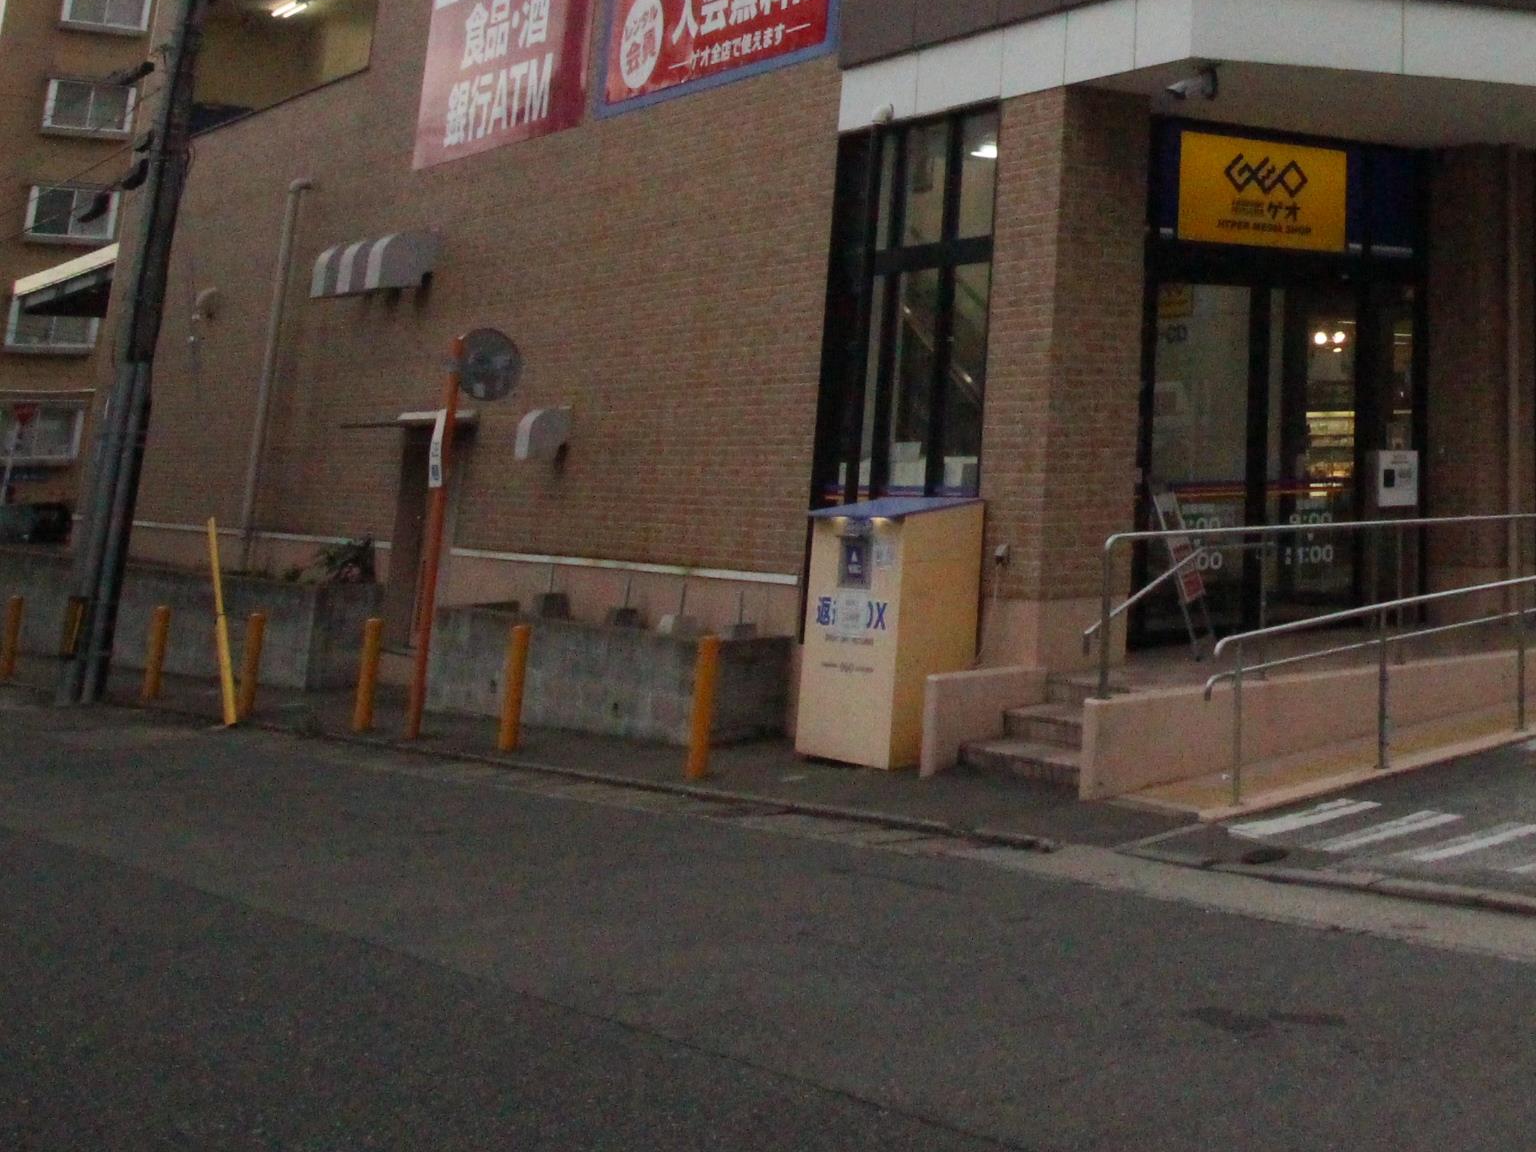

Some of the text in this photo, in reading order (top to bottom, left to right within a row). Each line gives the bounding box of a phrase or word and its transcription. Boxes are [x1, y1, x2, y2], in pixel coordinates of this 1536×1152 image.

[444, 53, 553, 147] 銀行ATM
[1267, 201, 1300, 222] ゲオ
[1217, 219, 1250, 230] HYPER
[1285, 224, 1312, 235] SHOP
